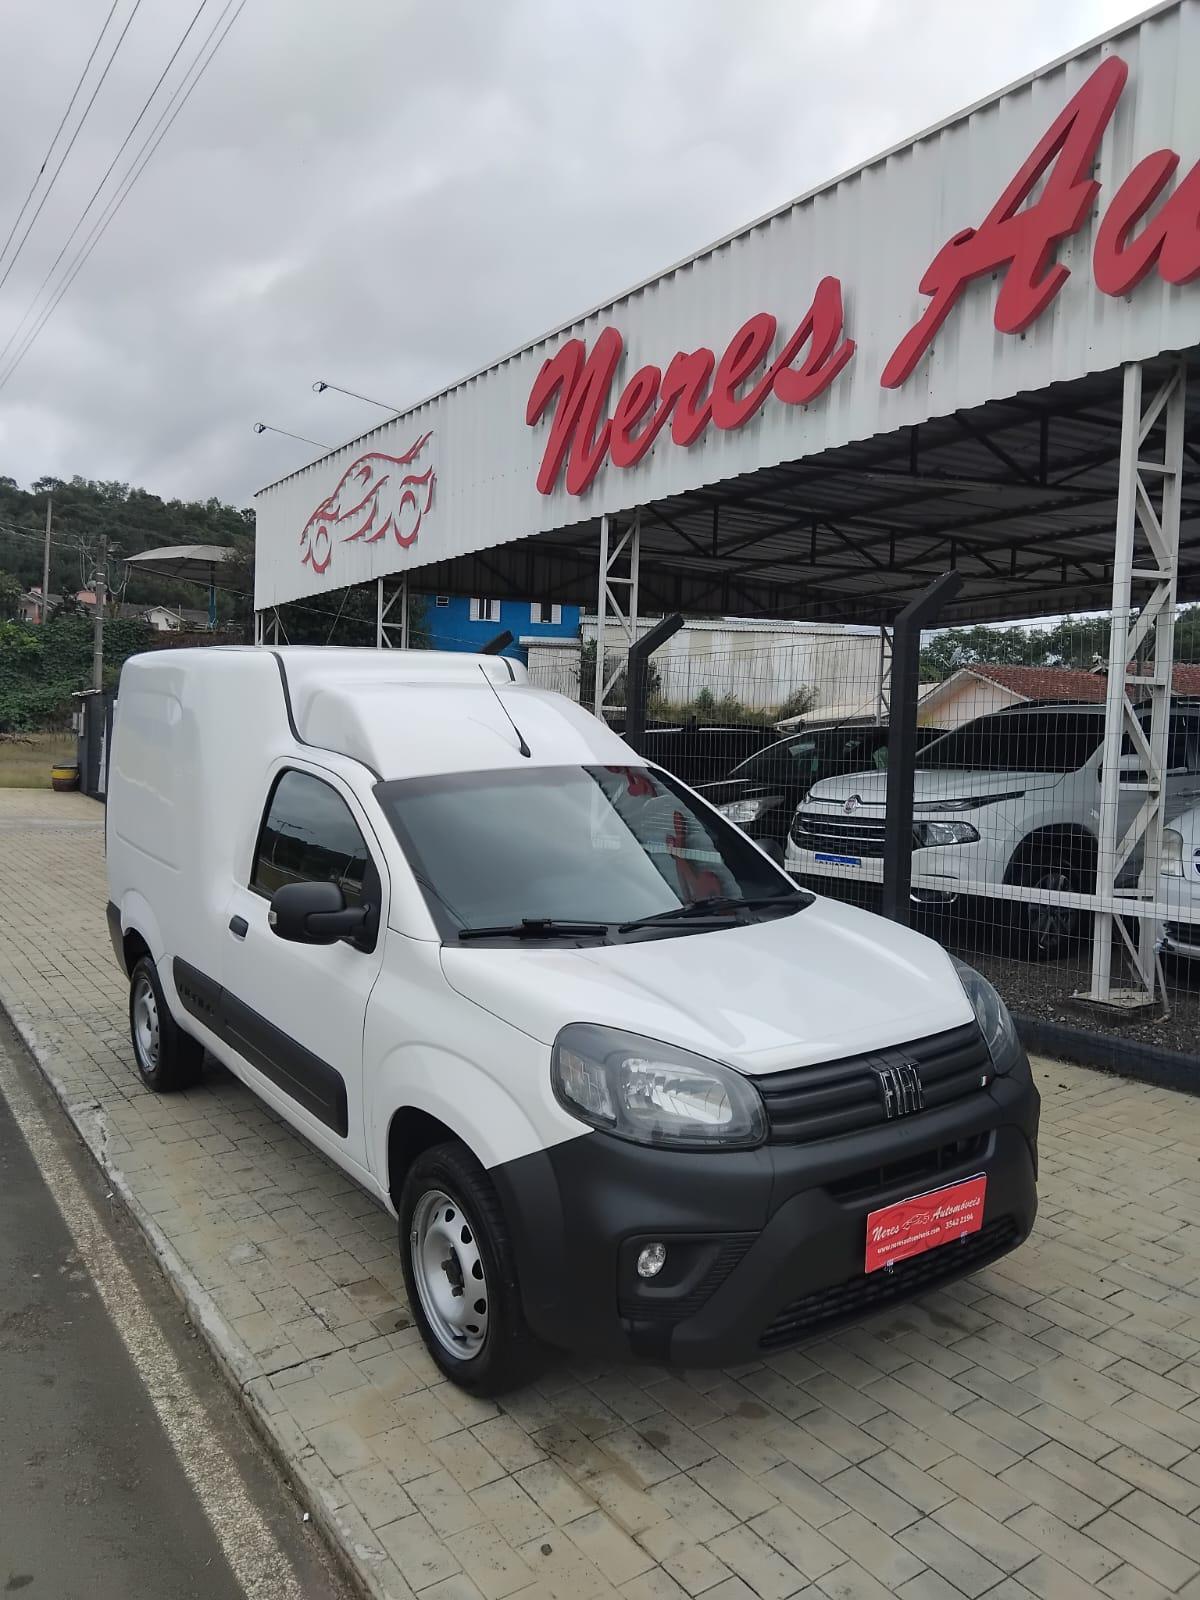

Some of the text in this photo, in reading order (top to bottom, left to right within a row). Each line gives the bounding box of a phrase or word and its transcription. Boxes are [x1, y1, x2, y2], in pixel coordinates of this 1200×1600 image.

[526, 275, 857, 496] Neres
[879, 1062, 925, 1119] FIAT
[872, 1224, 900, 1243] Neres
